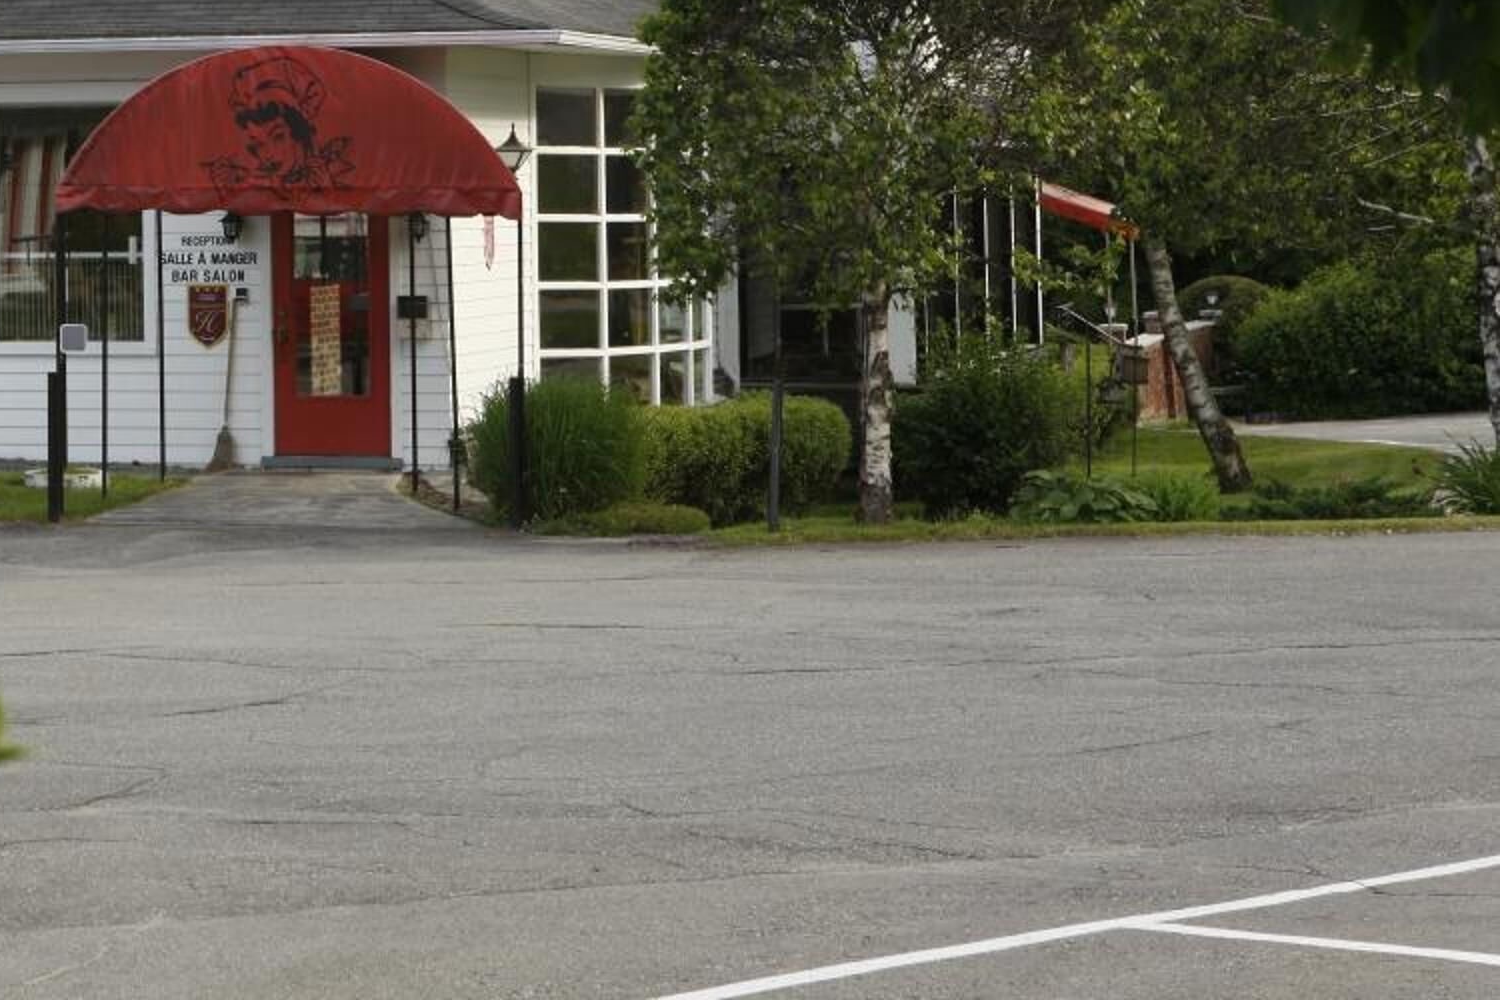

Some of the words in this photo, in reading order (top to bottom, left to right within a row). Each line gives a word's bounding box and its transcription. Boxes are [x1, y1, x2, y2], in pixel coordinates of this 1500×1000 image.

[160, 252, 193, 265] SALLE
[211, 252, 258, 265] MANGER
[171, 269, 198, 283] BAR
[203, 269, 245, 283] SALON
